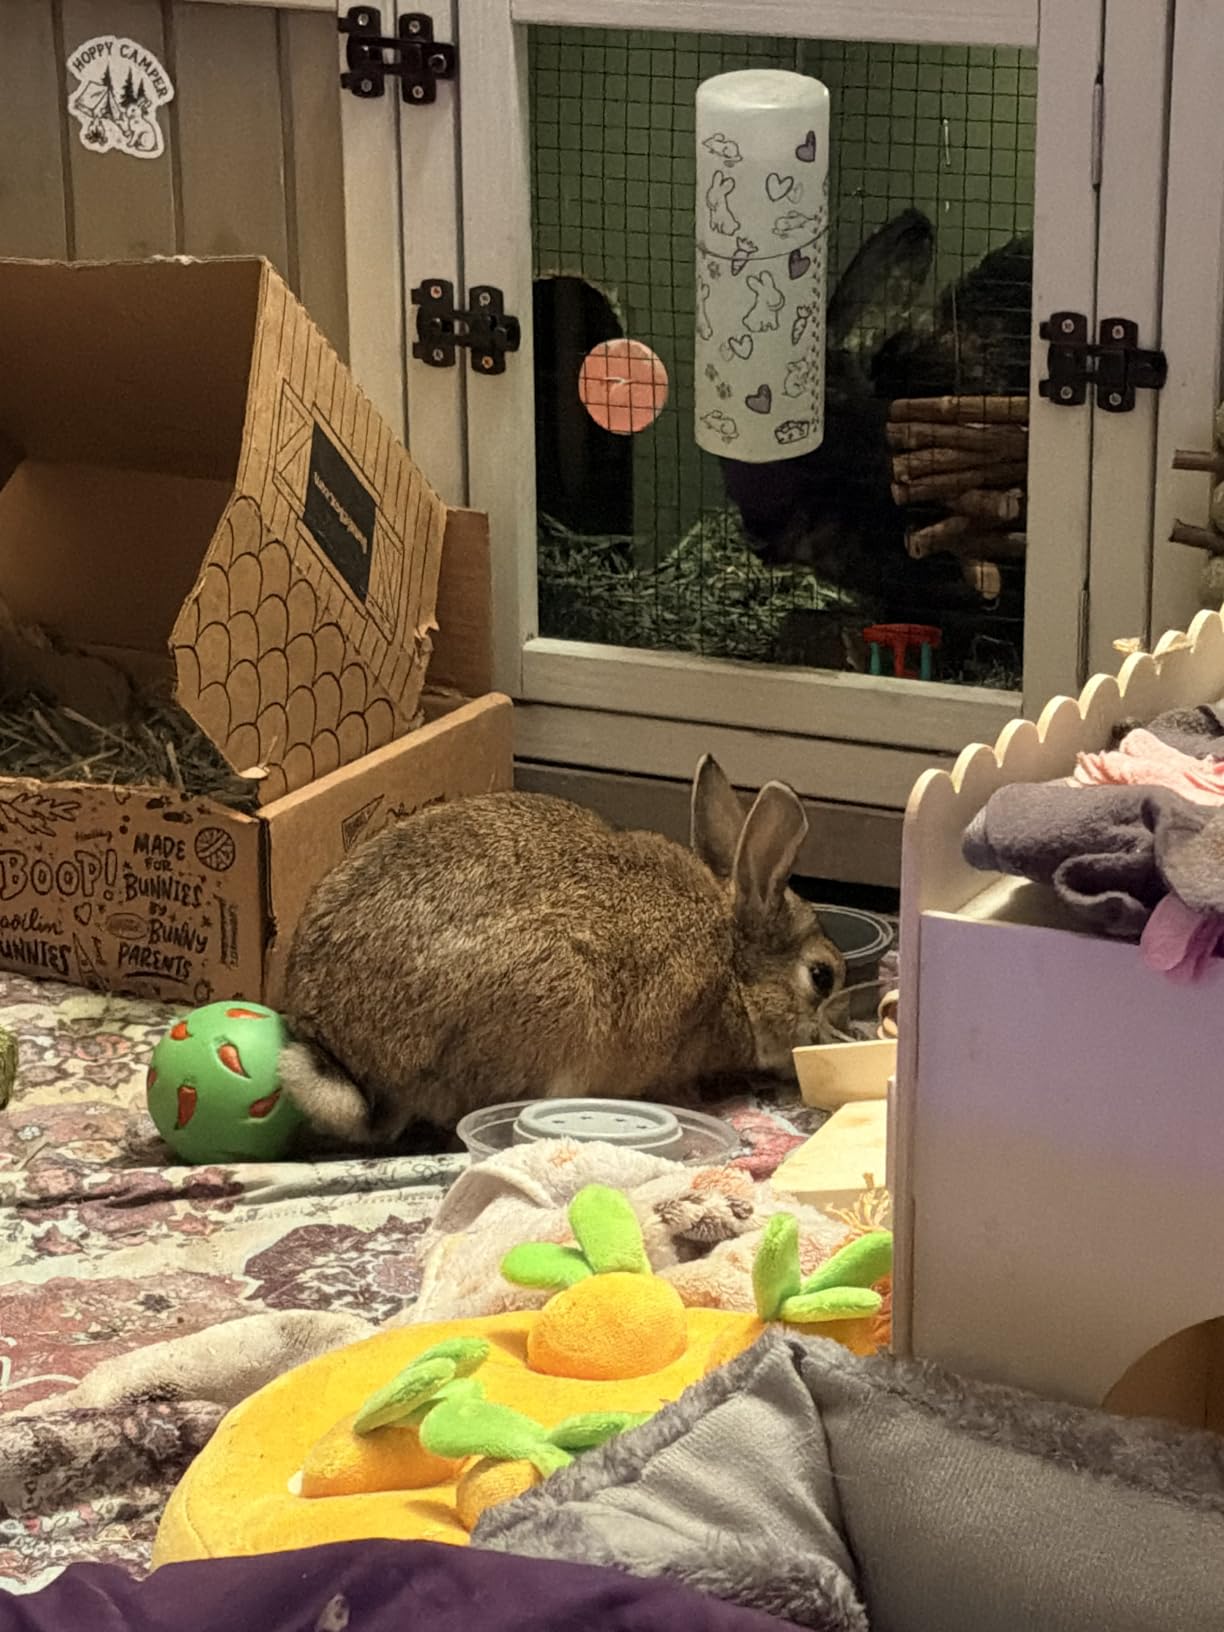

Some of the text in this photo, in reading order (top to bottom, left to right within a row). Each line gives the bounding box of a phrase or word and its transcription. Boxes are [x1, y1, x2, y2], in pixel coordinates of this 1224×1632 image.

[72, 41, 168, 99] HOPPY CAMPER
[133, 833, 187, 861] MADE
[0, 849, 118, 901] BOOP!
[145, 858, 173, 872] FOR
[123, 873, 203, 908] BUNNIES
[0, 937, 72, 976] UNNIES
[117, 944, 193, 979] PARENTS
